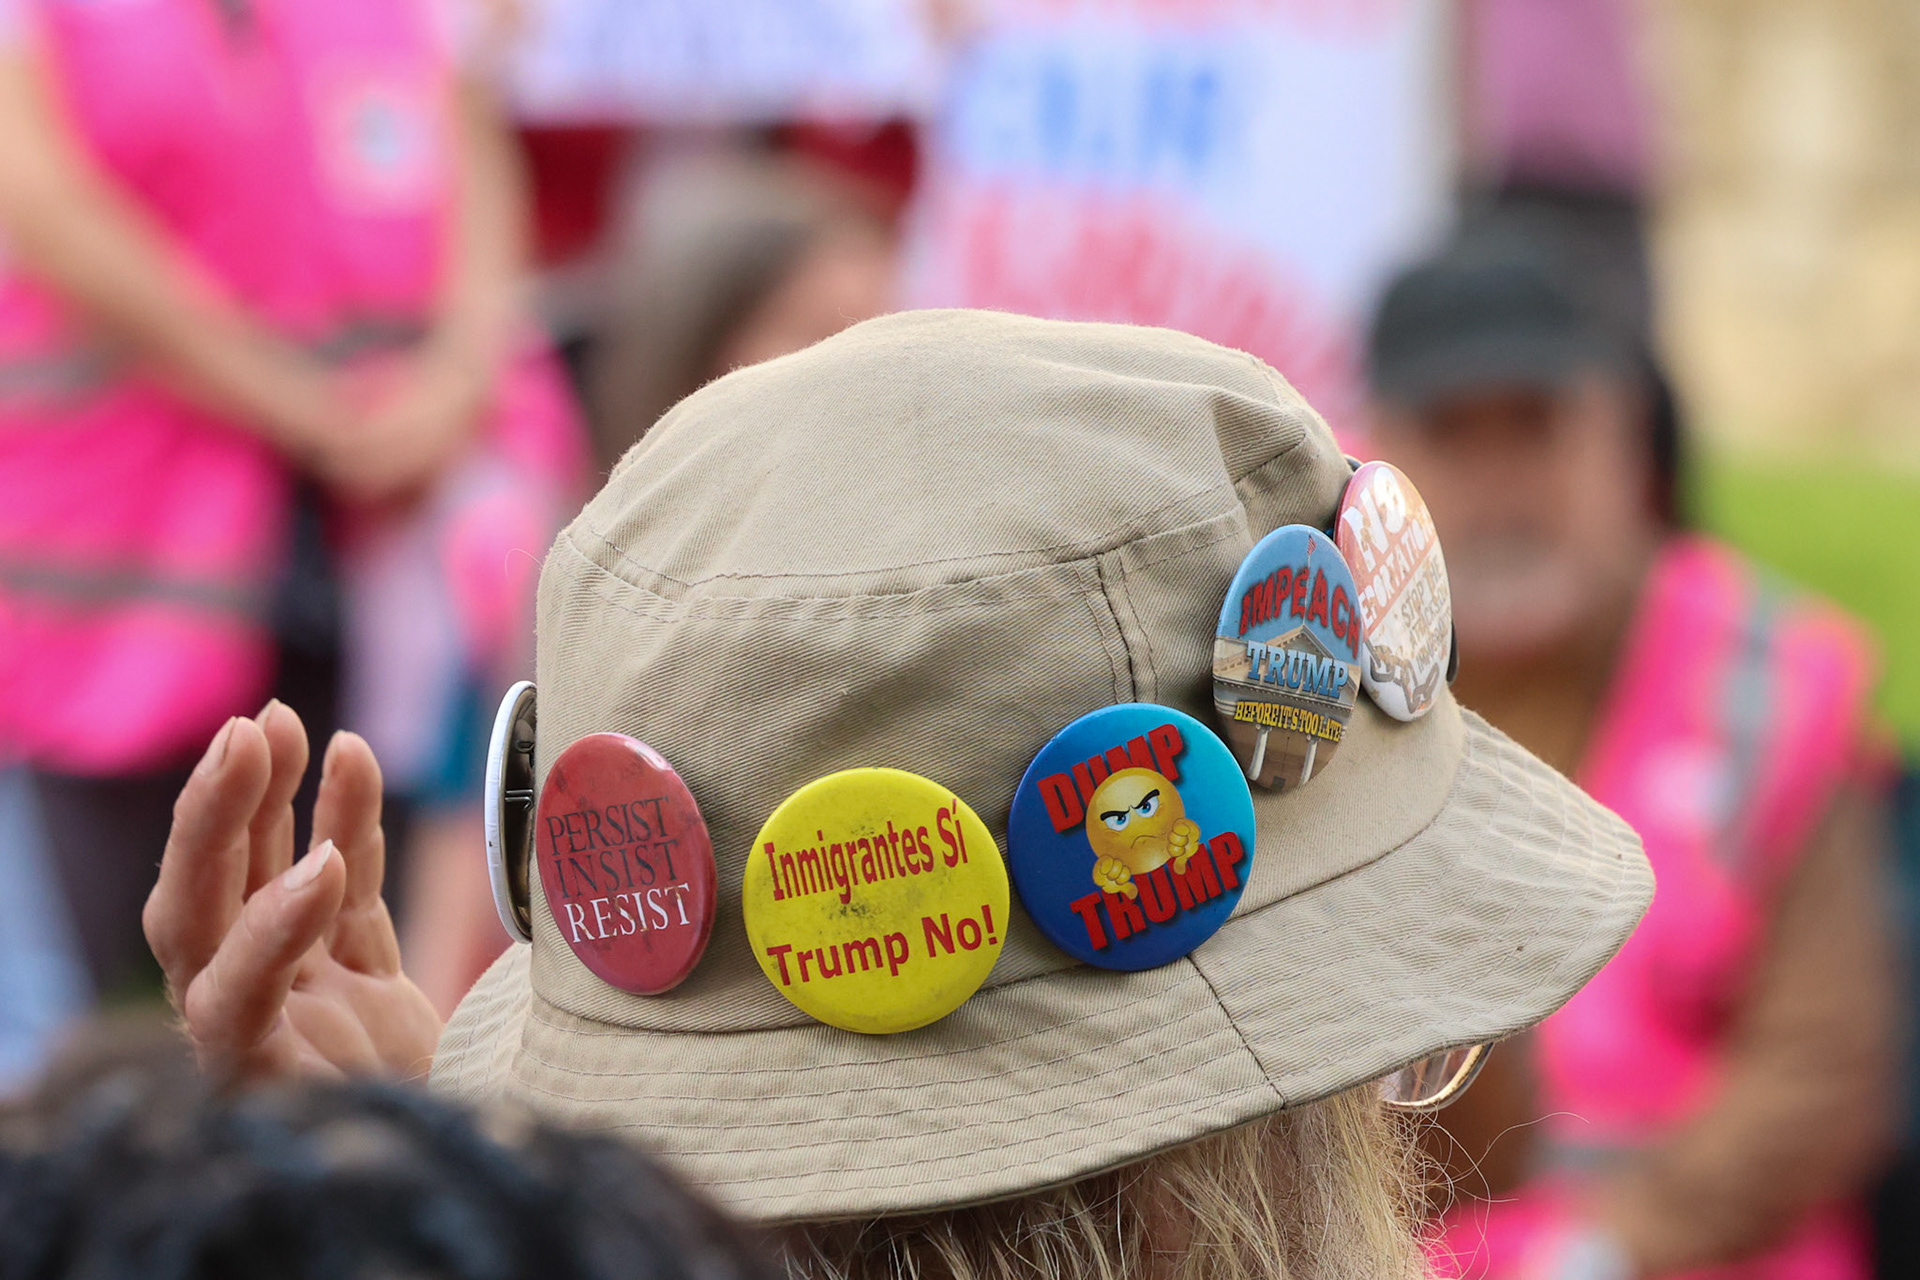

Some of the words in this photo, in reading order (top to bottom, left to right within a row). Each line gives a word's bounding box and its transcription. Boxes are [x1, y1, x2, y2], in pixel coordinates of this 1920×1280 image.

[1342, 467, 1405, 573] NO
[1238, 565, 1361, 660] IMPEACH
[1401, 578, 1425, 628] STOP
[1422, 554, 1443, 601] THE
[1247, 640, 1349, 699] TRUMP
[1234, 701, 1279, 728] BEFORE
[1277, 705, 1299, 731] IT'S
[1298, 708, 1319, 735] TOO
[1318, 715, 1342, 742] LATE
[1036, 723, 1184, 833] DUMP
[546, 795, 669, 856] PERSIST
[763, 820, 934, 905] Inmigrantes
[936, 798, 968, 868] Sí
[553, 839, 678, 899] INSIST
[1070, 831, 1244, 951] TRUMP
[564, 883, 690, 943] RESIST
[766, 931, 910, 987] Trump
[921, 904, 998, 958] No!
